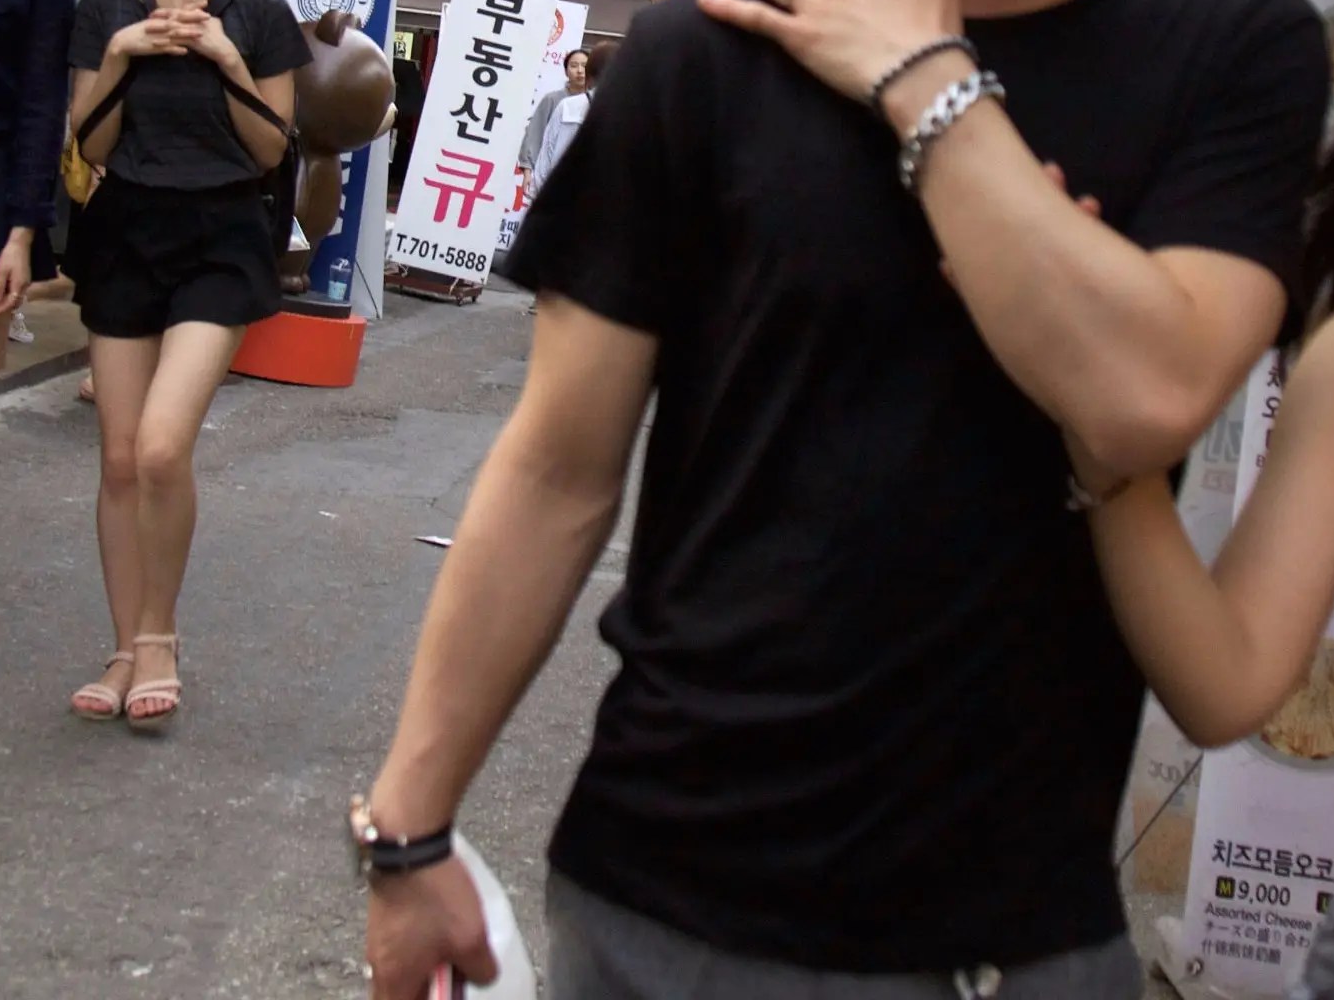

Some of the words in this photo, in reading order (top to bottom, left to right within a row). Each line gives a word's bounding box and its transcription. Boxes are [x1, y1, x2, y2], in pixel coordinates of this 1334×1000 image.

[424, 147, 495, 229] 큐
[396, 233, 487, 273] T.701-5888
[1238, 880, 1291, 907] 9,000
[1205, 902, 1261, 924] Assorted
[1265, 912, 1313, 931] Cheese
